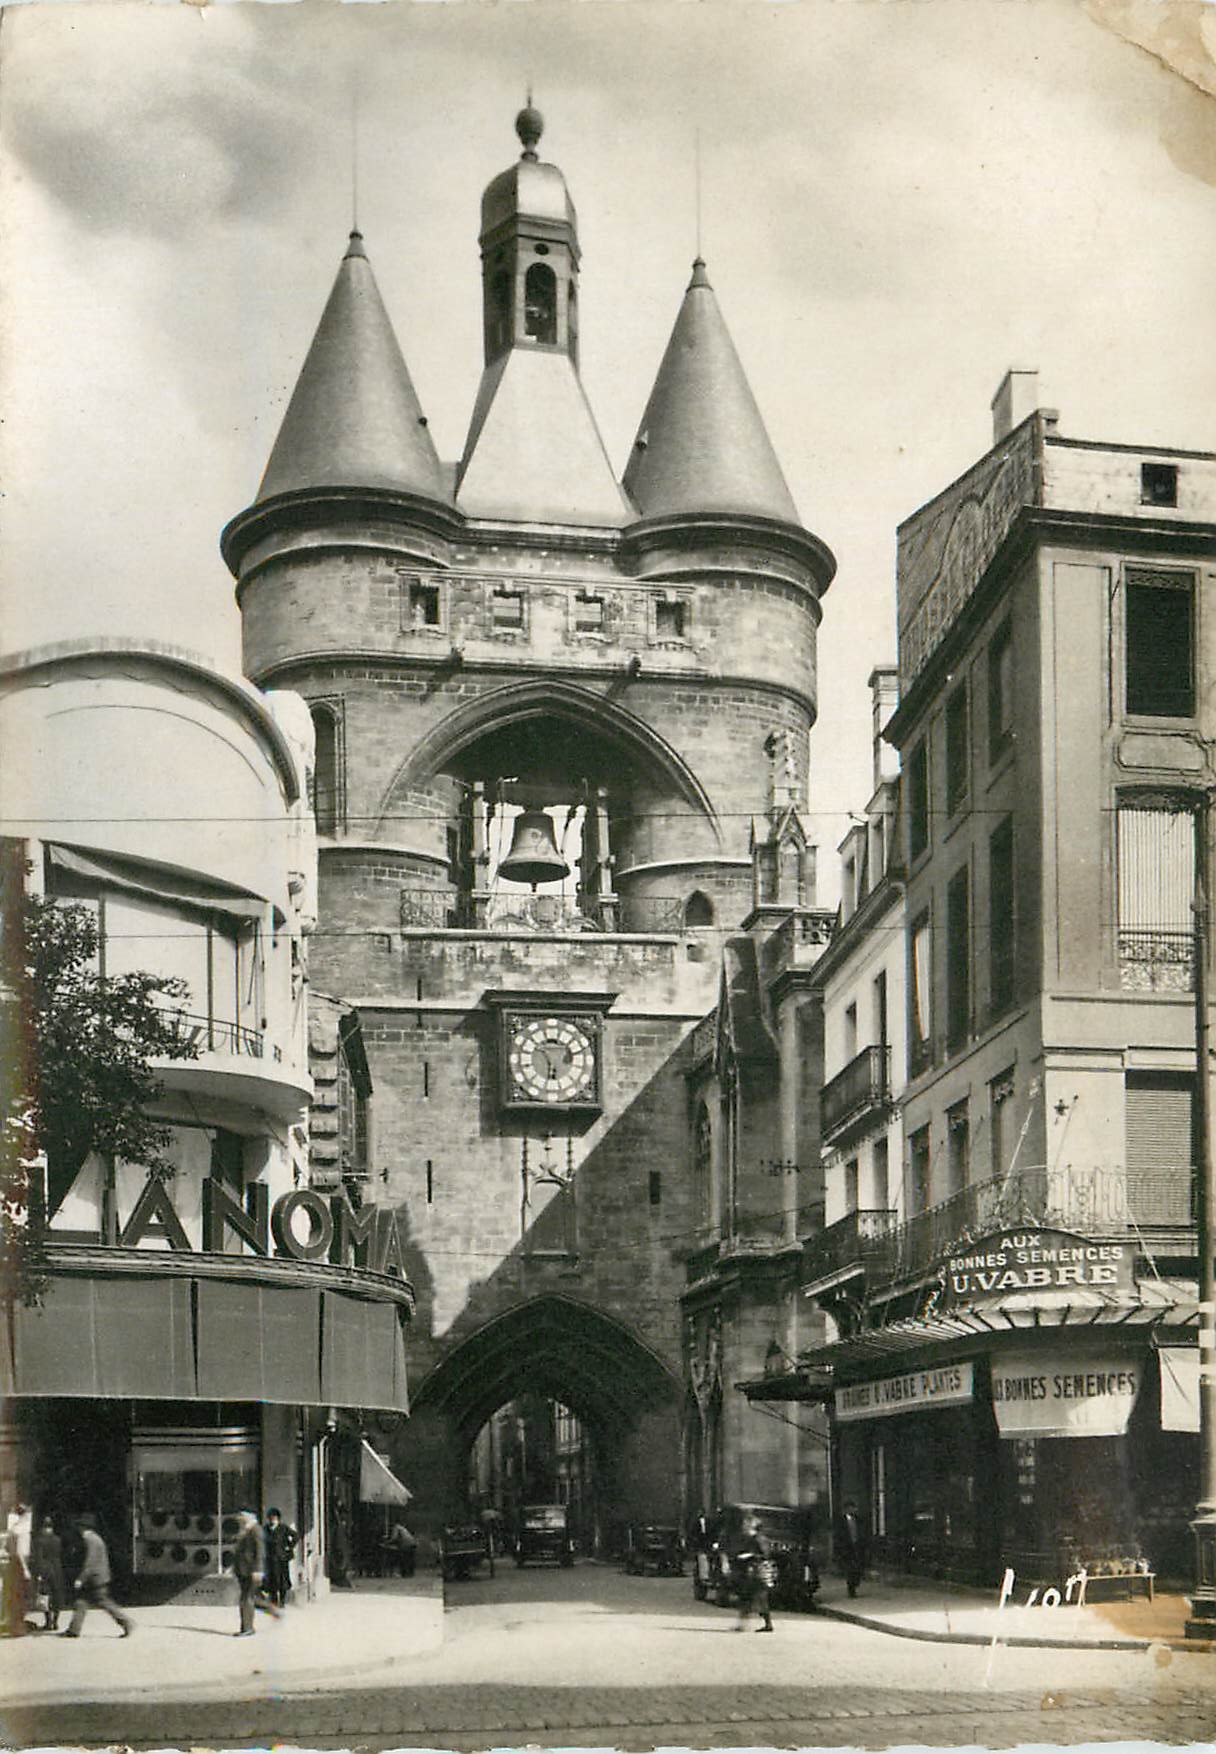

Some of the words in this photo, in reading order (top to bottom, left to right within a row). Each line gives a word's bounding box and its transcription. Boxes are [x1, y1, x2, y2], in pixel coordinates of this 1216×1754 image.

[1000, 1235, 1041, 1250] AUX
[950, 1253, 1008, 1272] BONNES
[1016, 1246, 1124, 1264] SEMENCES
[1053, 1372, 1136, 1399] SEMENCES
